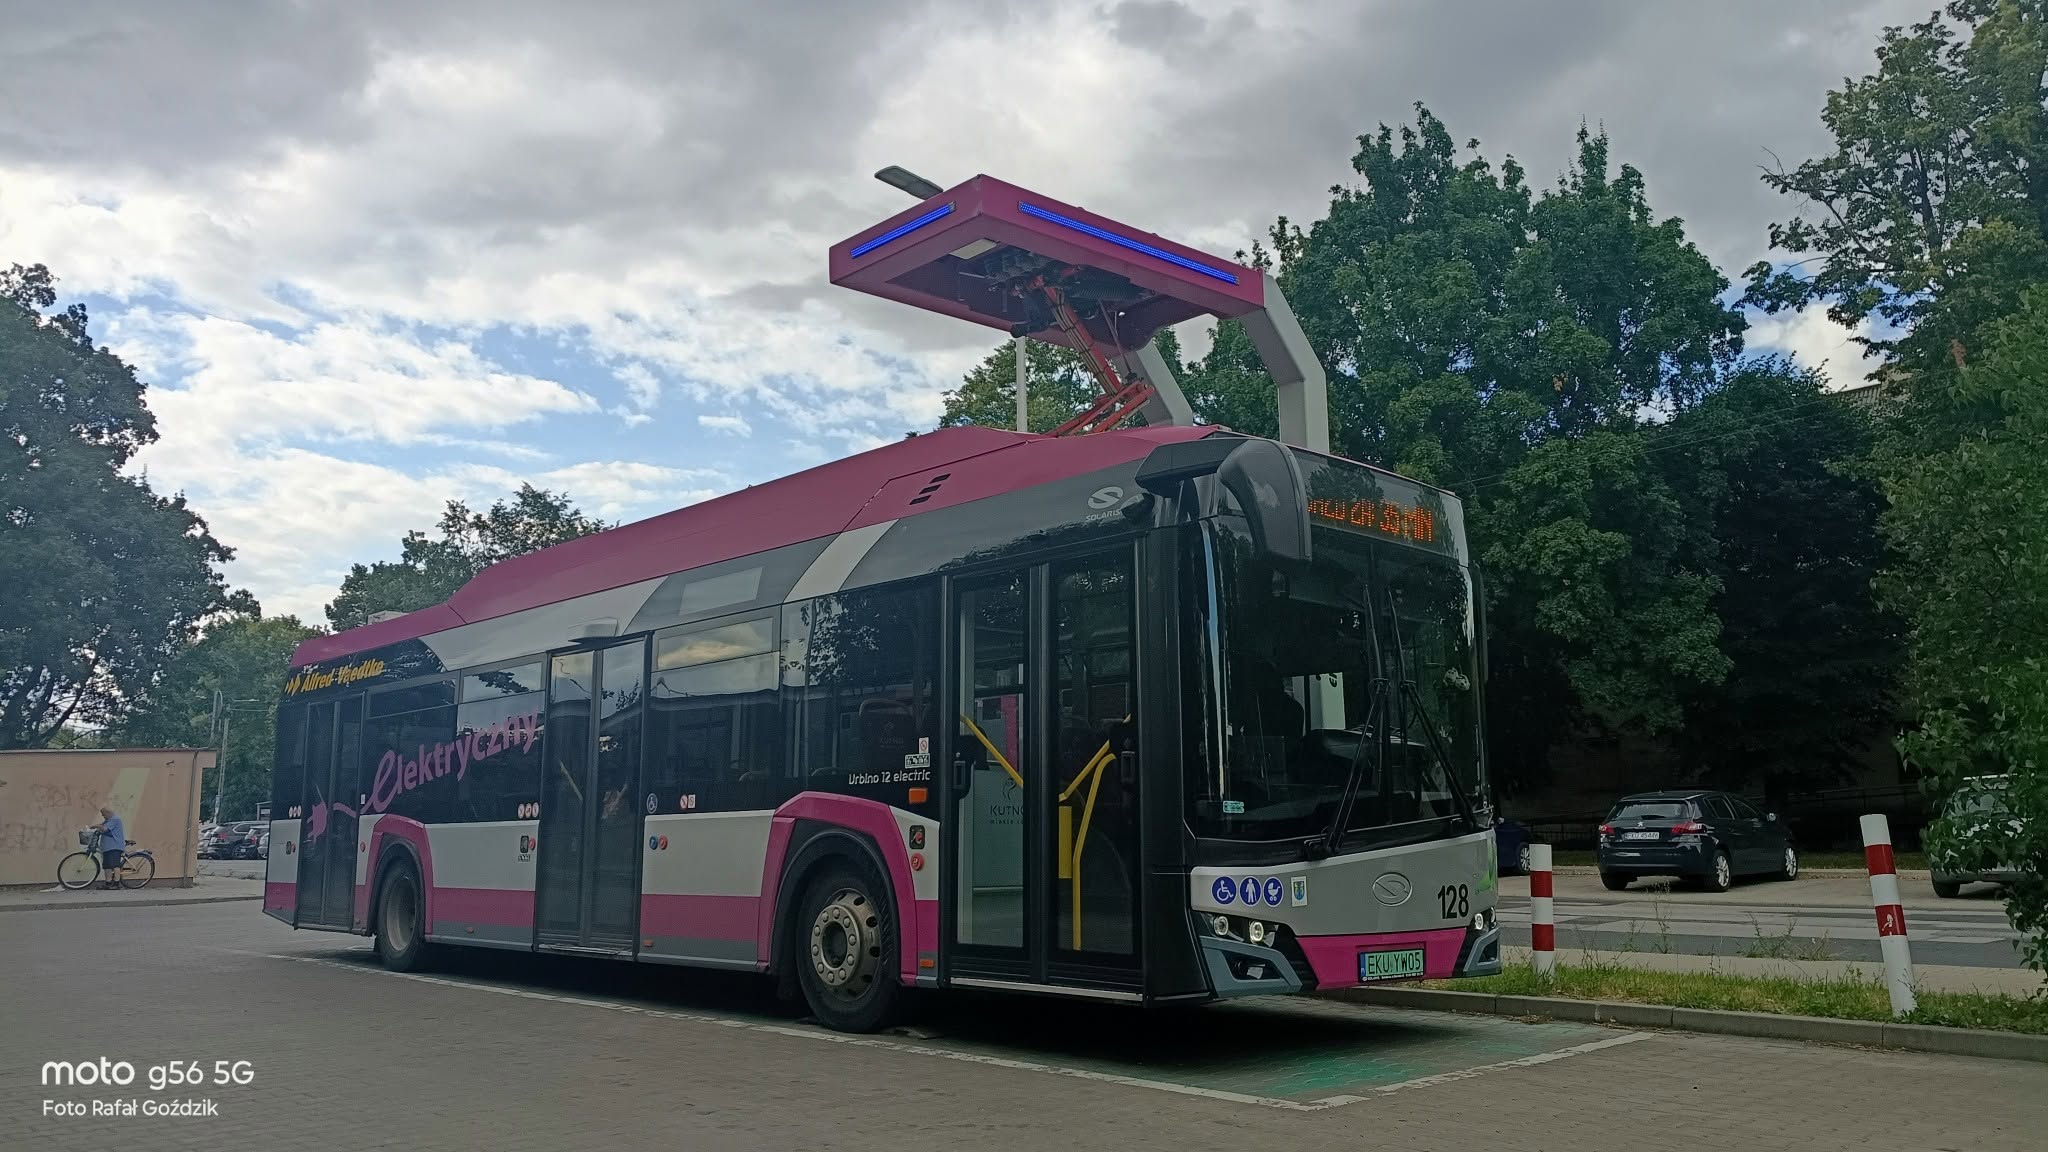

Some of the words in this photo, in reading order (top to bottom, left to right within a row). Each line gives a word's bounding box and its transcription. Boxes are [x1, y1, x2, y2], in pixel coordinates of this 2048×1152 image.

[1085, 508, 1121, 522] SOLARIS
[300, 667, 335, 693] Alfred
[848, 773, 880, 785] Urbino
[881, 771, 891, 783] 12
[893, 769, 931, 782] electric
[1438, 883, 1470, 920] 128
[1368, 954, 1390, 974] EKU
[1393, 952, 1421, 972] YW05
